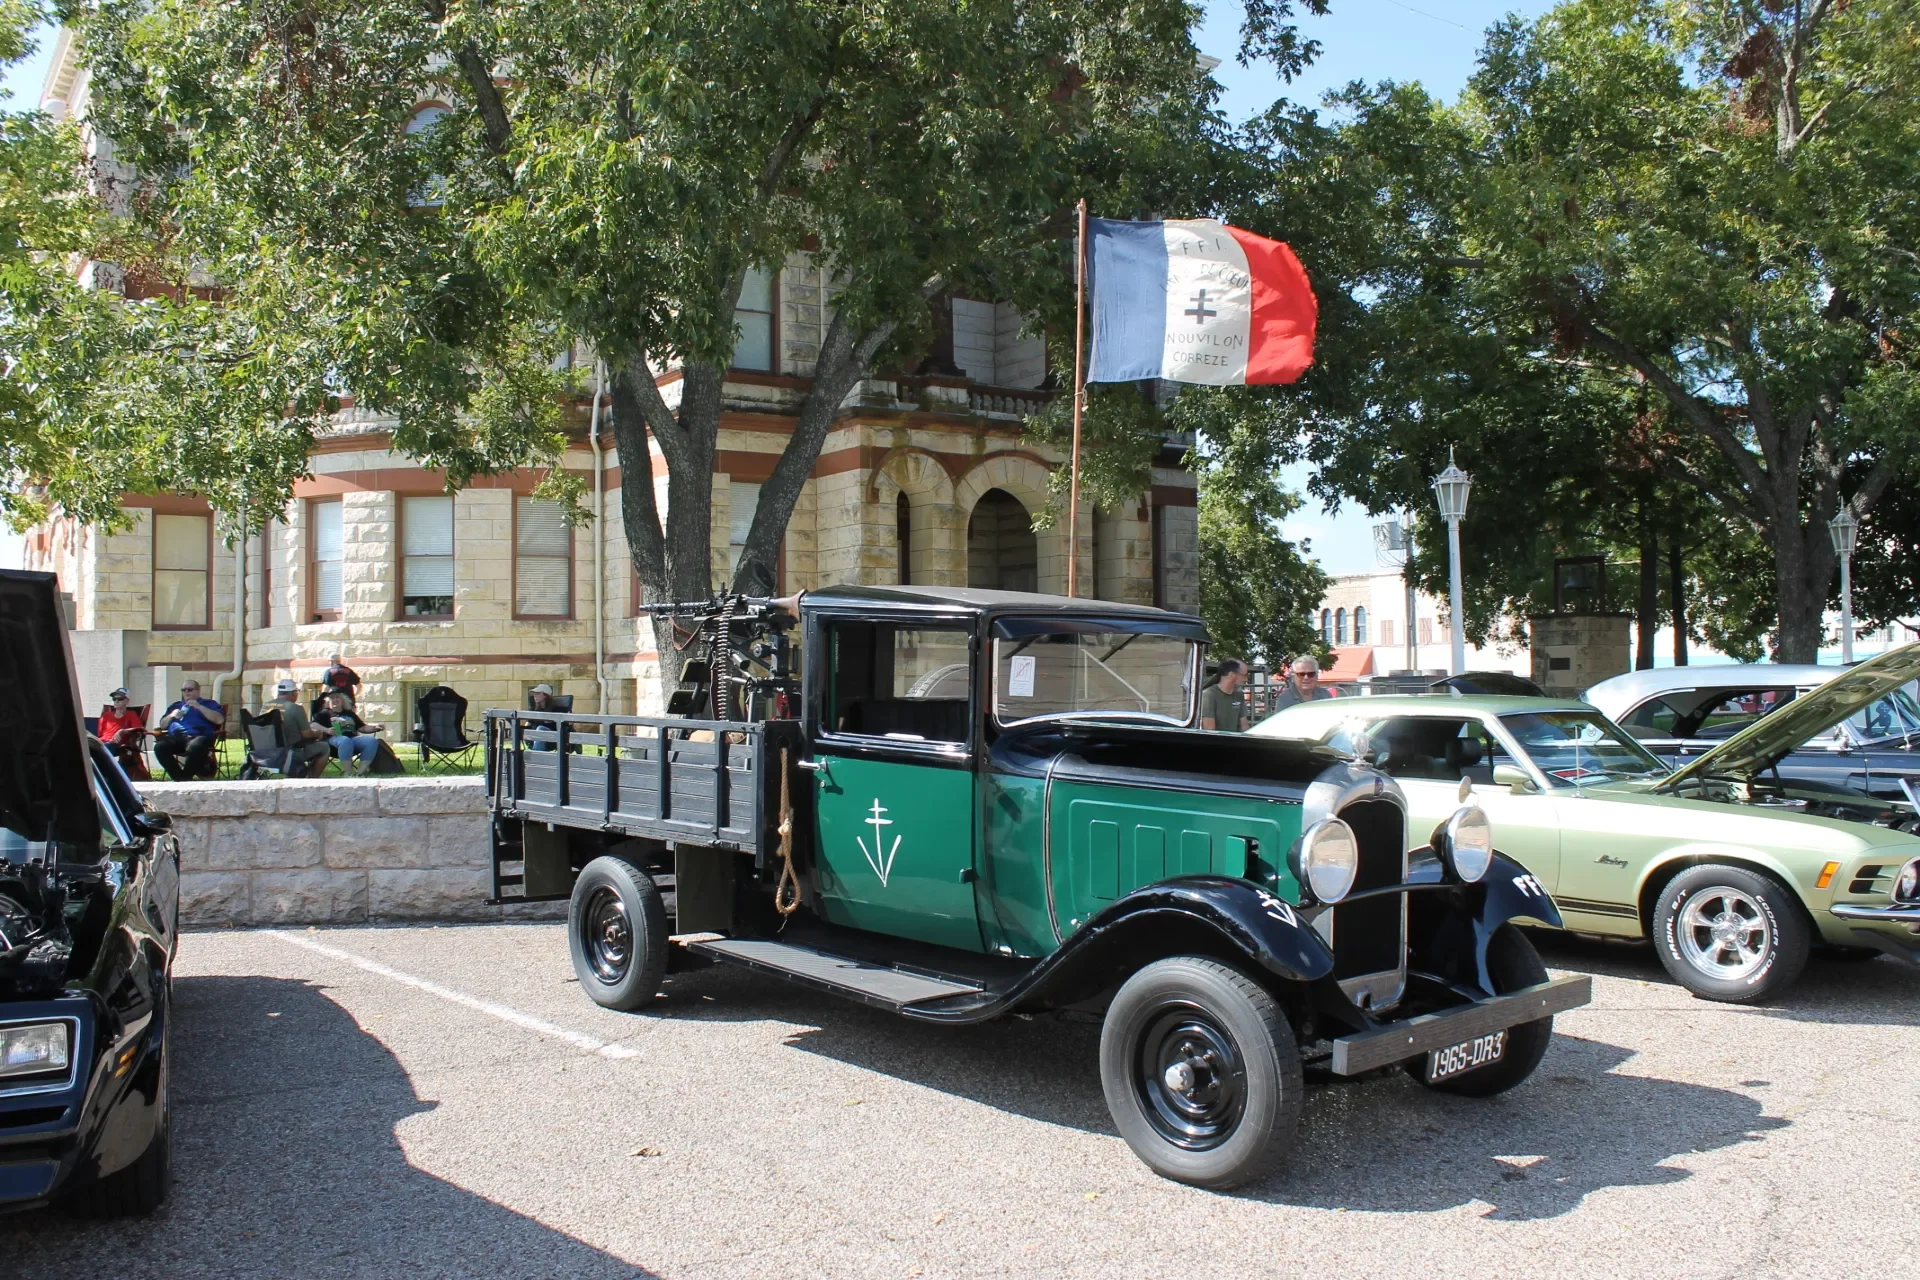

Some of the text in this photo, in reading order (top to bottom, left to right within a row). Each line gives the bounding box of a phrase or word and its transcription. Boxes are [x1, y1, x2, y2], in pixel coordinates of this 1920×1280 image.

[1167, 332, 1244, 349] NOUVILON
[1172, 351, 1229, 367] CORREZE
[1665, 915, 1682, 961] RADIAL
[1746, 894, 1779, 985] COOPER COBRA
[1431, 1031, 1504, 1079] 1965-DR3
